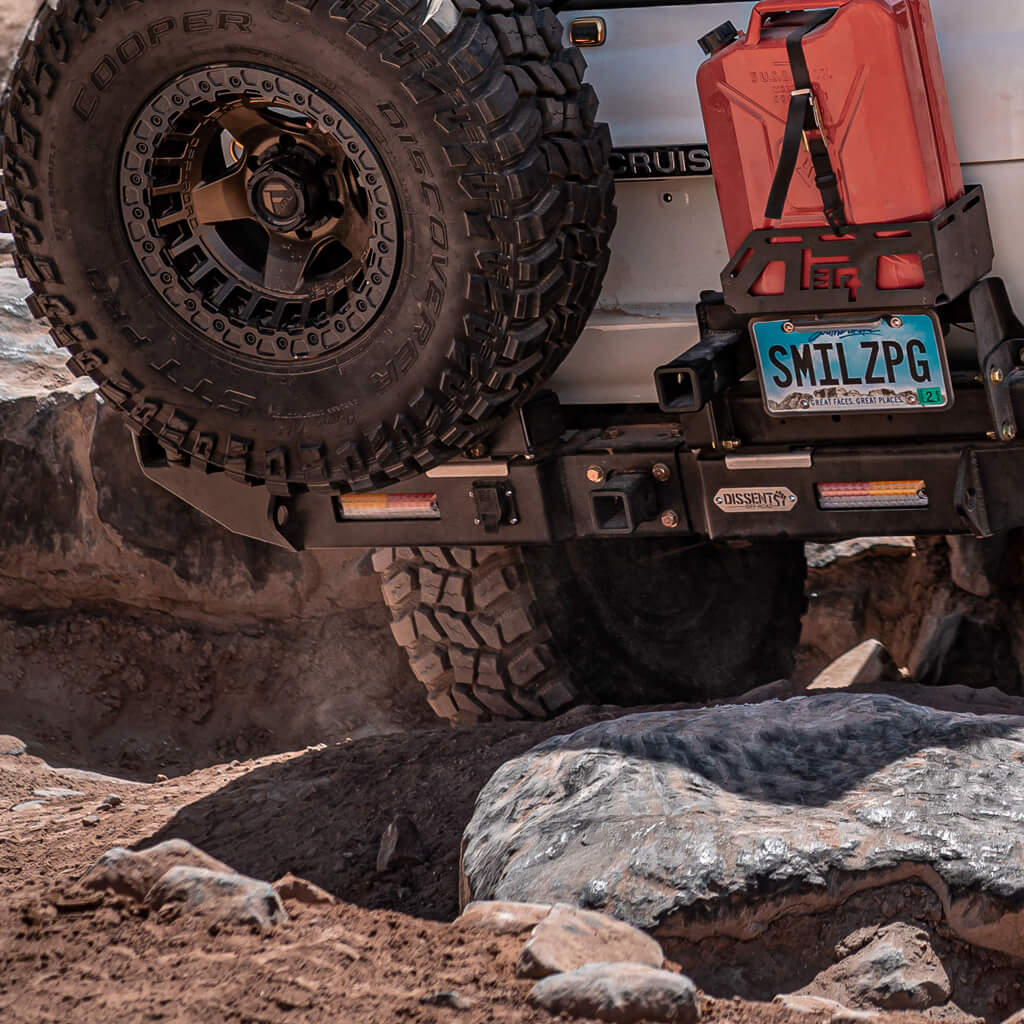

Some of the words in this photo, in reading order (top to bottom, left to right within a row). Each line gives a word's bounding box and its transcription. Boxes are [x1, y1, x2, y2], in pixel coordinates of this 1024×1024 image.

[72, 9, 256, 123] COOPER
[768, 339, 932, 389] SMILZPG
[810, 397, 832, 407] GREAT
[855, 396, 877, 406] GREAT
[723, 491, 774, 505] DISSENT
